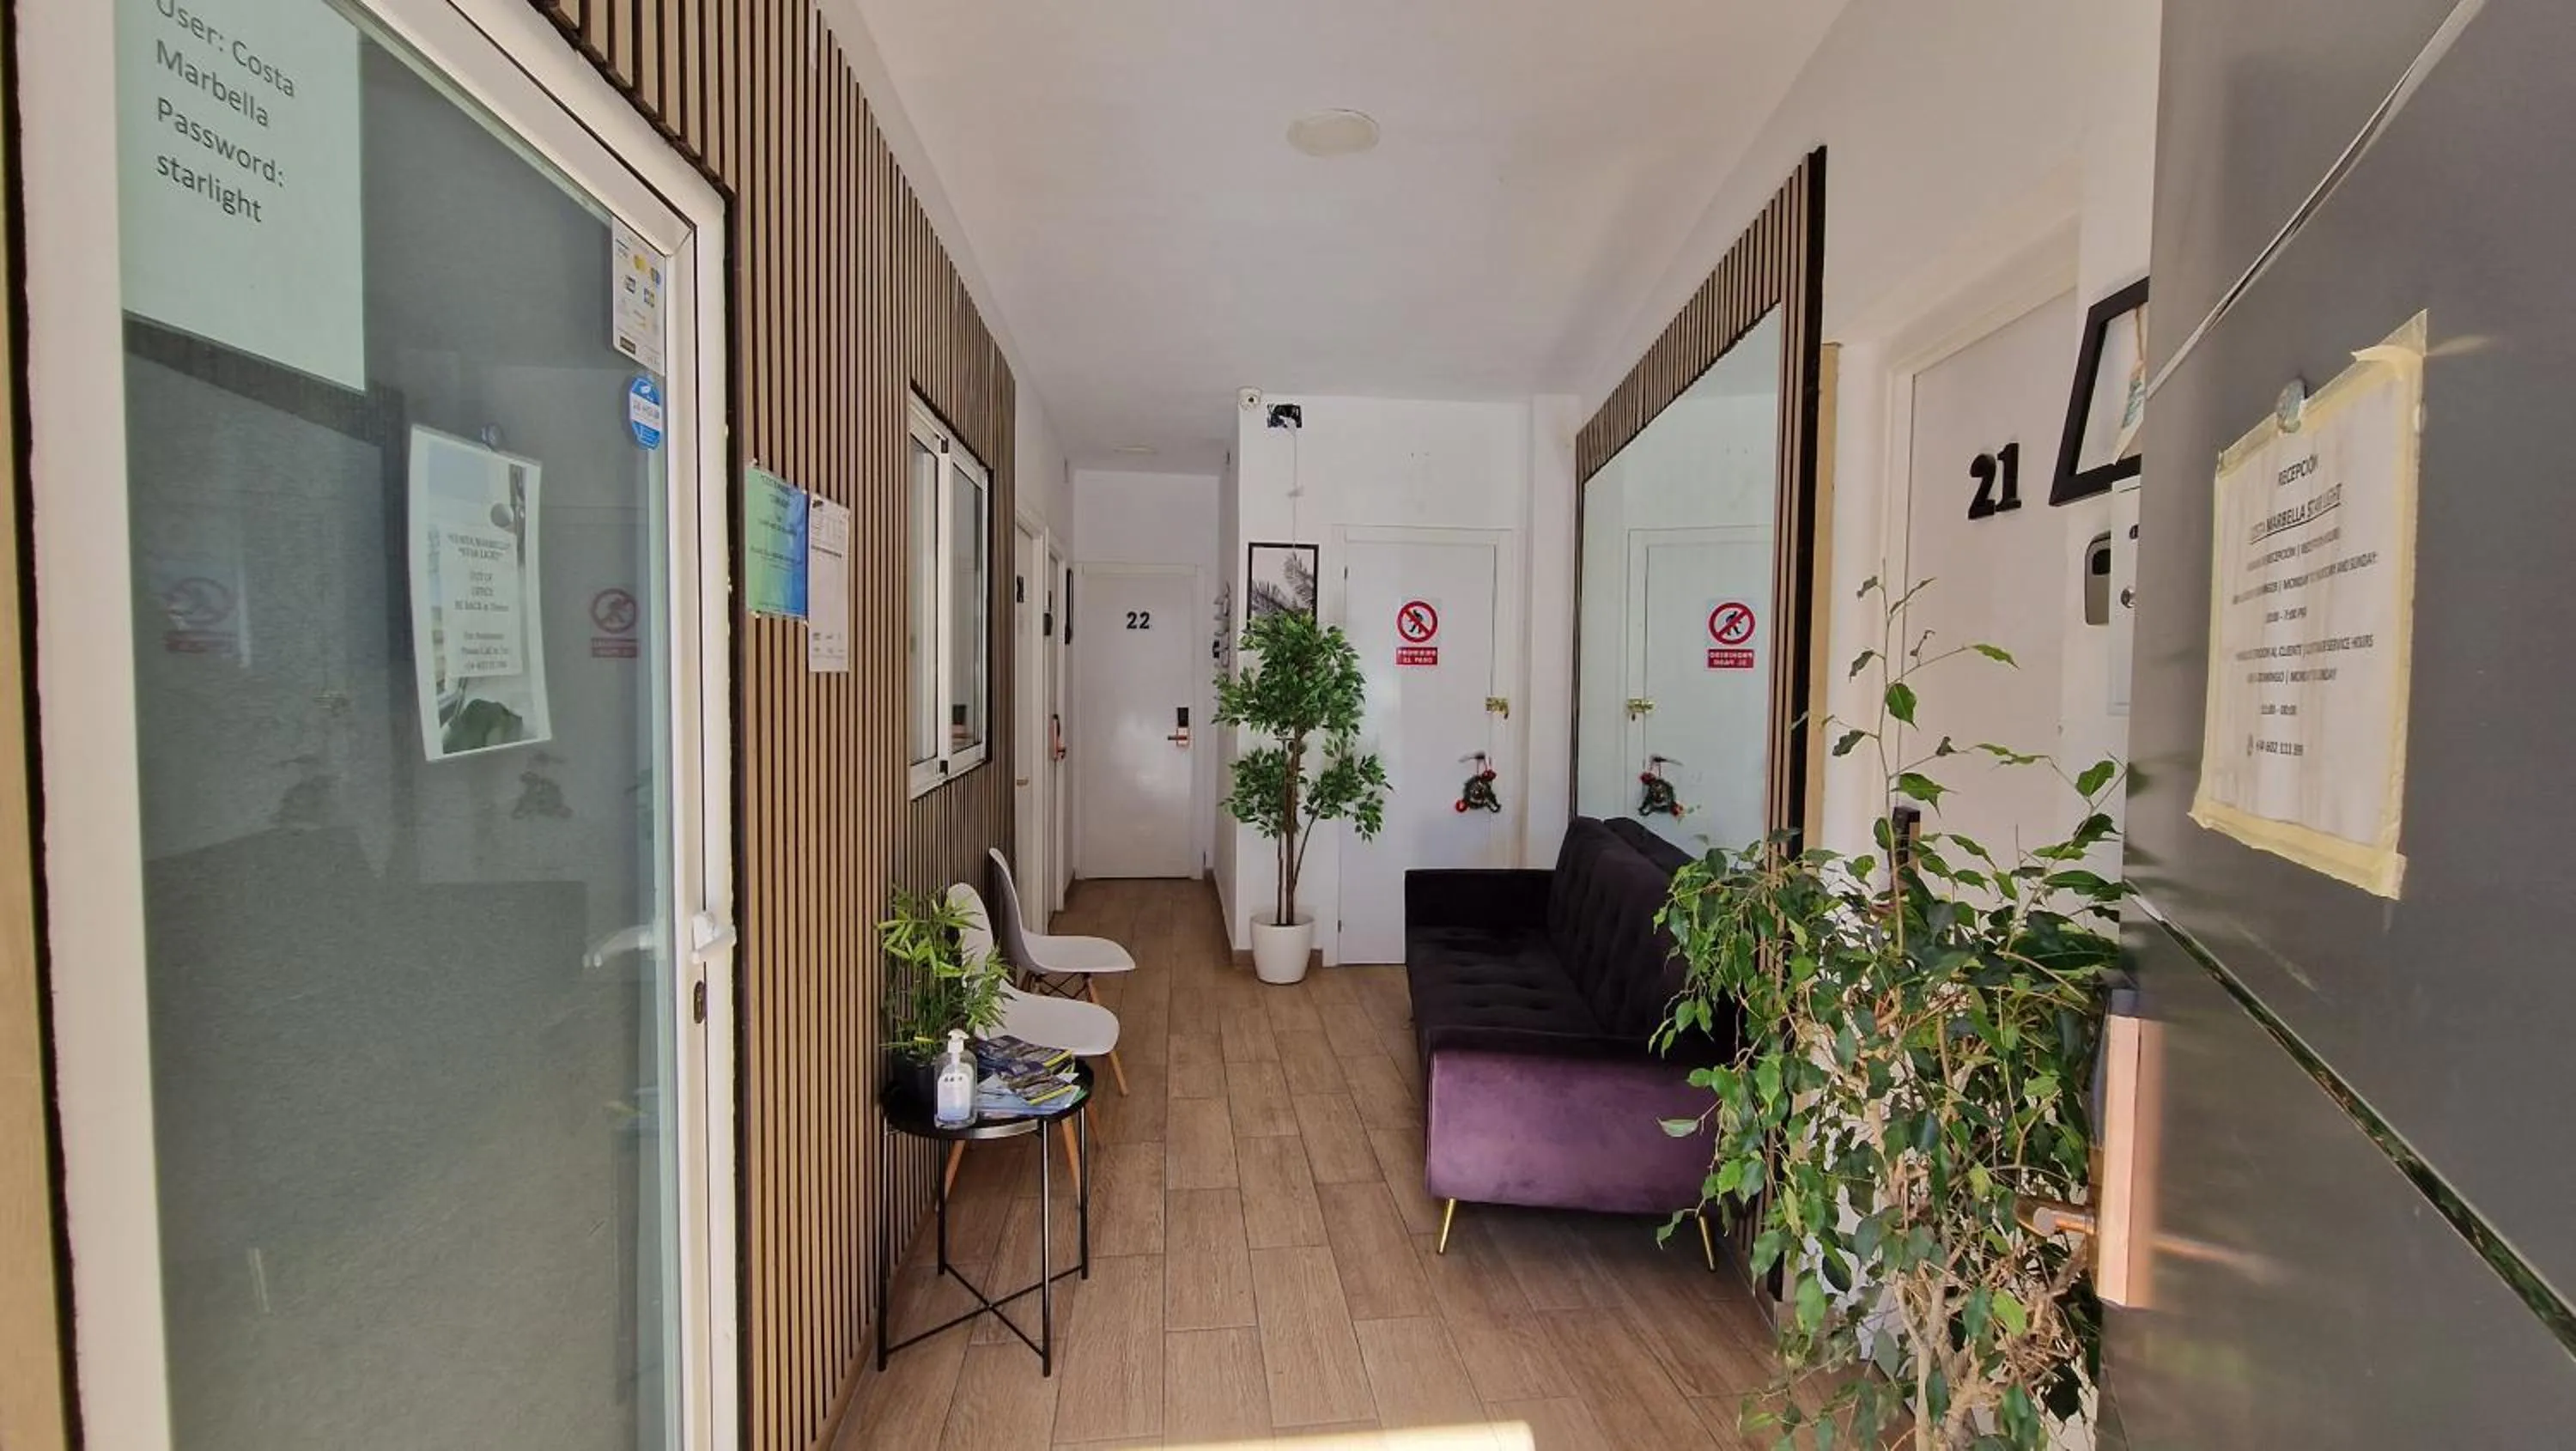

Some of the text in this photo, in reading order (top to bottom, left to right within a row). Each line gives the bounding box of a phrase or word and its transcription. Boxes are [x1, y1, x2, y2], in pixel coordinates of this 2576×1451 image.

[156, 39, 270, 127] Marbella
[232, 40, 295, 97] Costa
[157, 96, 284, 187] Password:
[156, 154, 262, 223] starlight
[1967, 442, 2022, 520] 21
[1126, 610, 1151, 629] 22
